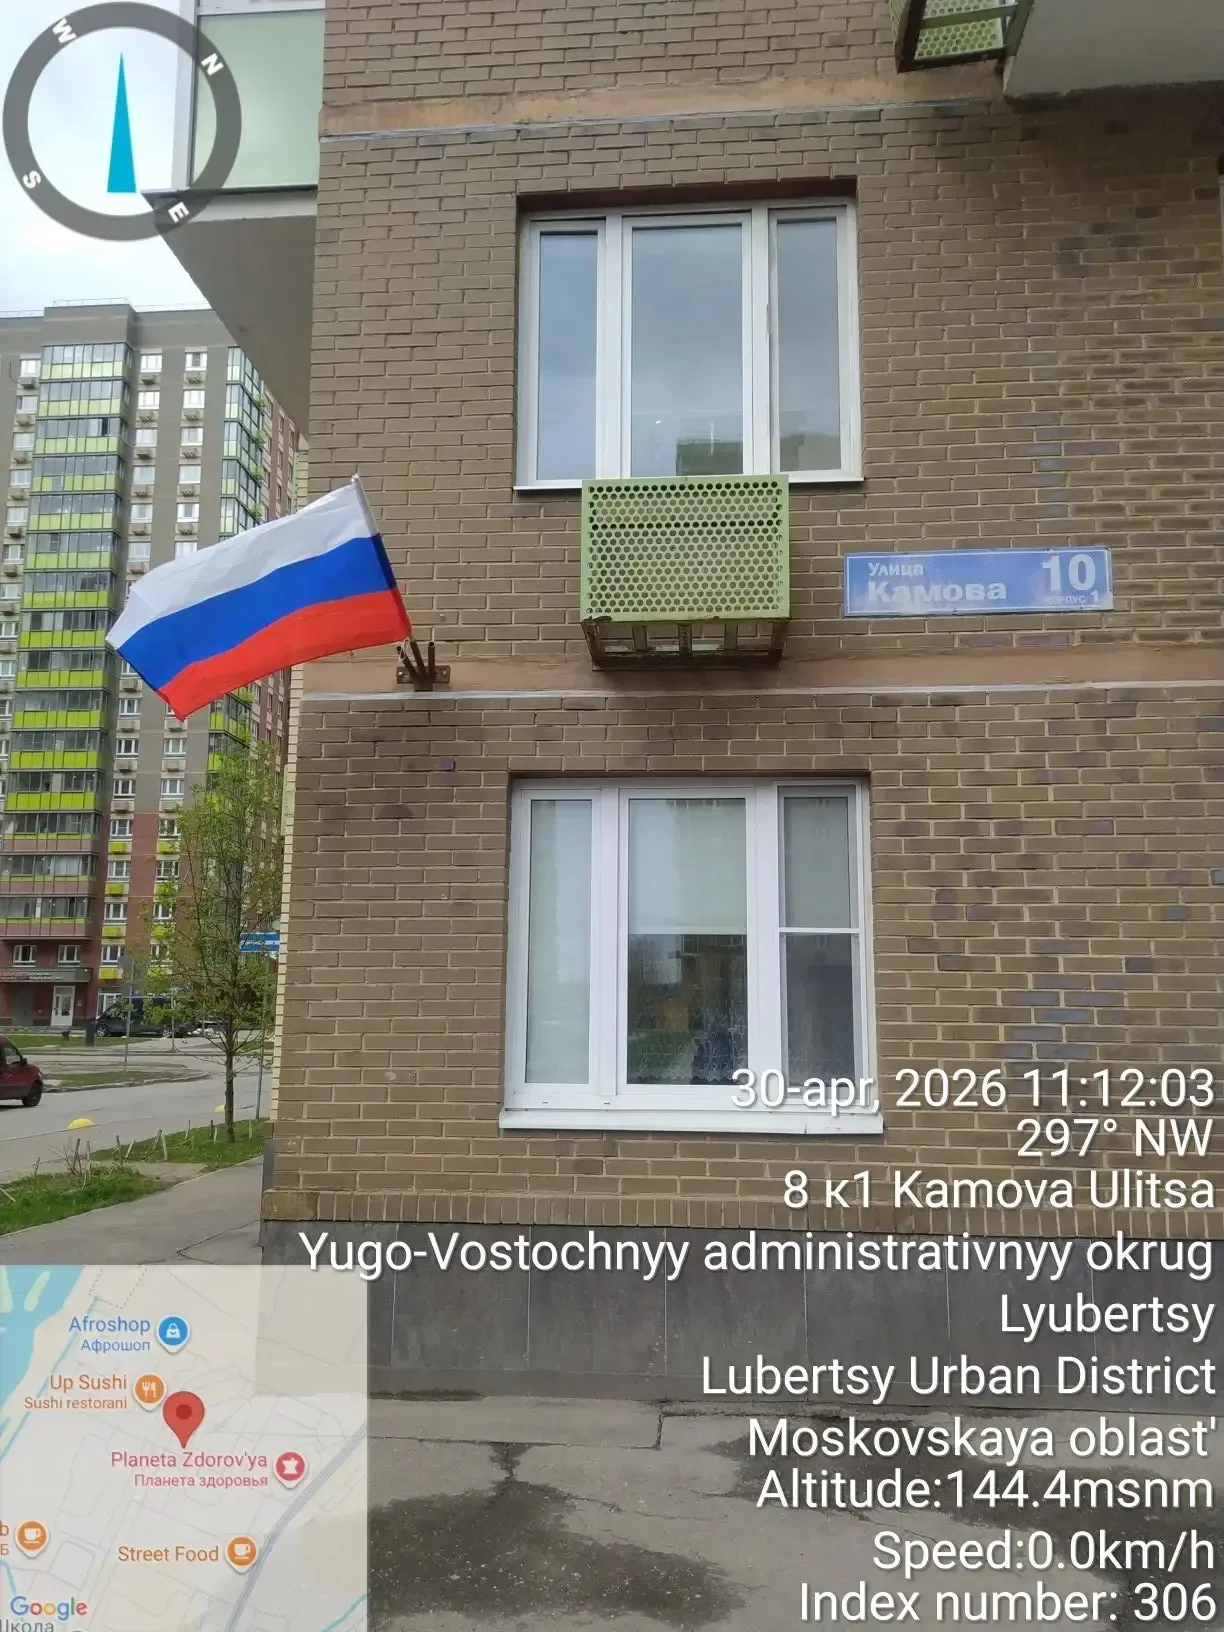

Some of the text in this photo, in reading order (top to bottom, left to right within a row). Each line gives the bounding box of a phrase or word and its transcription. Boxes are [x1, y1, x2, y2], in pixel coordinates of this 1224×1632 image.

[868, 562, 924, 577] Улица
[1041, 554, 1096, 591] 10
[867, 580, 1008, 603] Камова
[1090, 589, 1099, 604] 1
